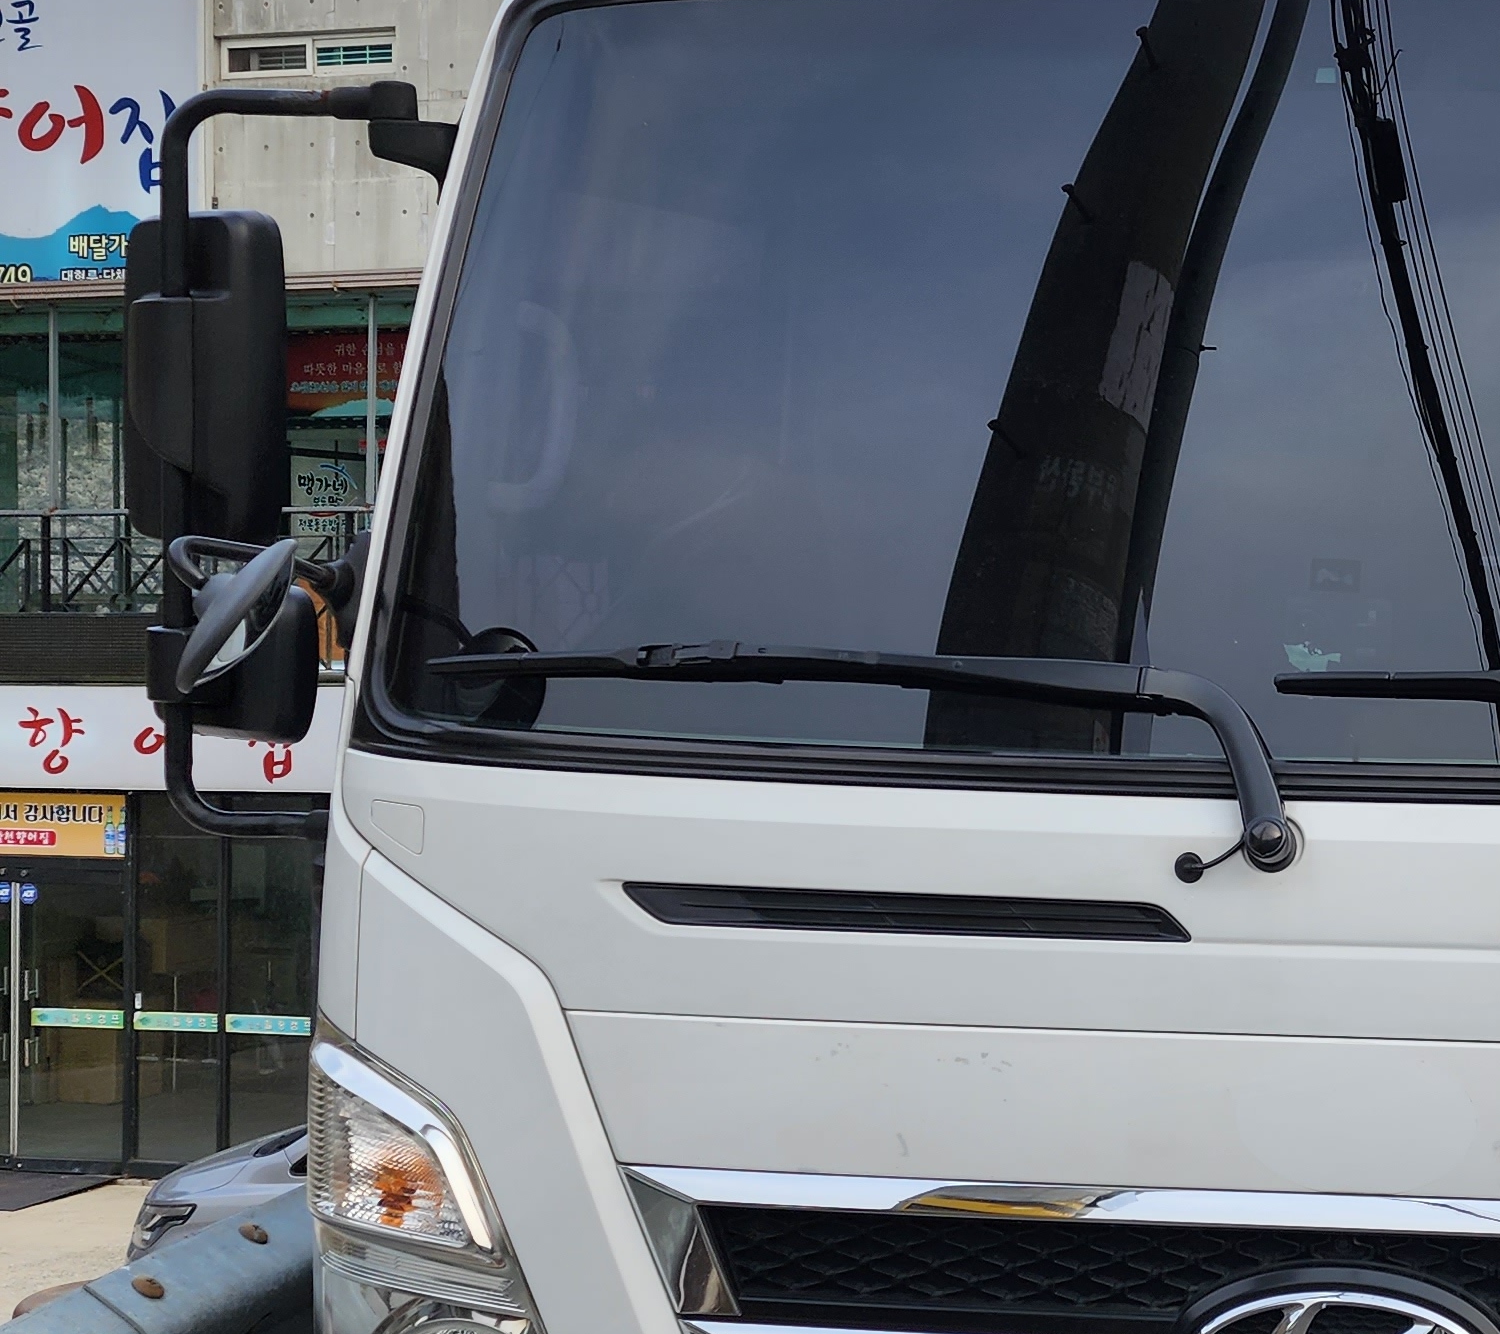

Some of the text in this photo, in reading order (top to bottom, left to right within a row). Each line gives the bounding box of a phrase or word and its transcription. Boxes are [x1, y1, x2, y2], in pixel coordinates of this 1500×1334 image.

[0, 0, 43, 52] 골
[0, 83, 177, 195] 어집
[342, 361, 388, 376] 마음로
[0, 804, 18, 821] 서
